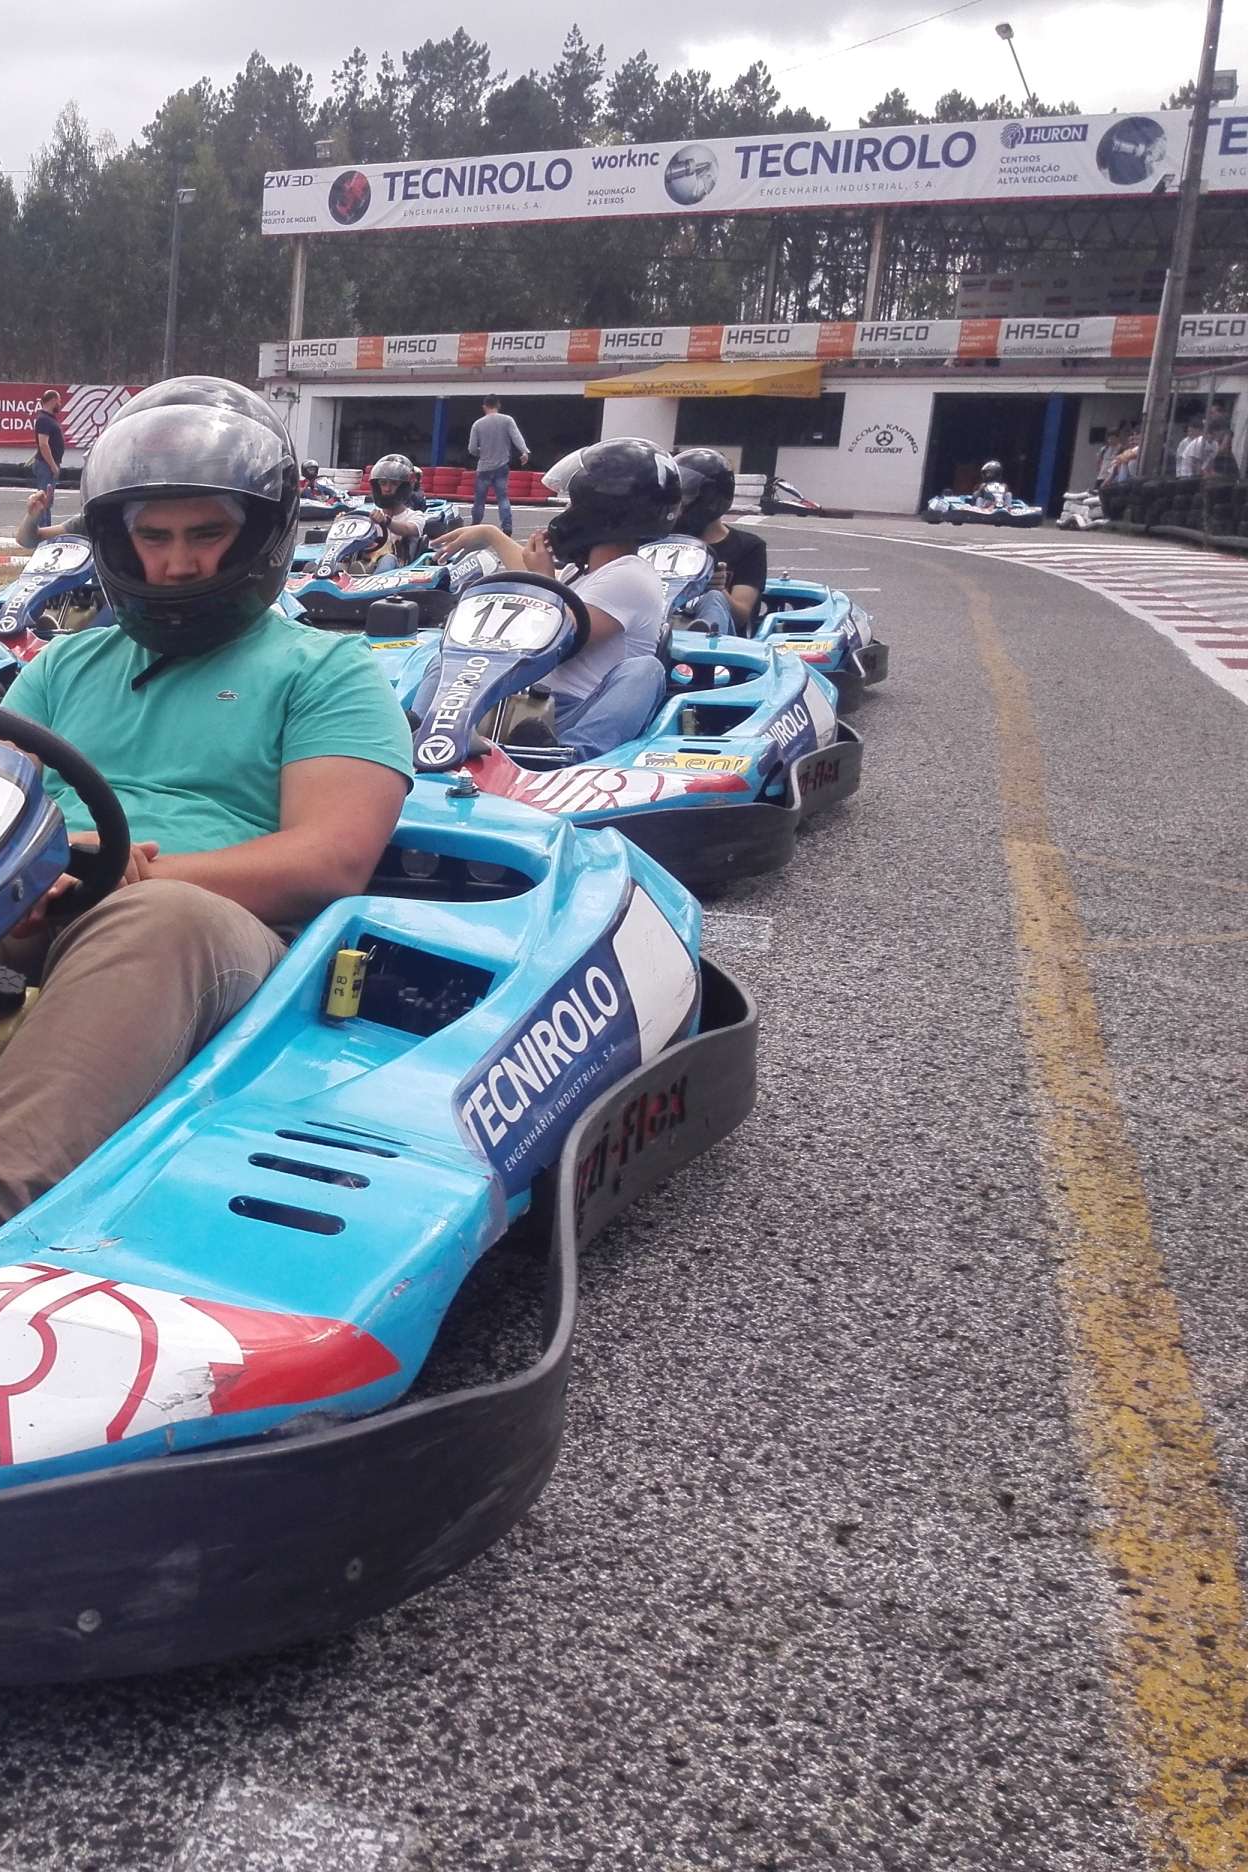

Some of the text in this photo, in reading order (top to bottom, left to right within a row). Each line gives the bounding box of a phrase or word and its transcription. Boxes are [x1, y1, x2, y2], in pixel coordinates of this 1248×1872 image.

[1029, 126, 1083, 142] HURON
[592, 150, 659, 169] worknc
[735, 131, 976, 179] TECNIROLO
[1000, 154, 1041, 164] CENTROS
[383, 158, 573, 201] TECNIROLO
[997, 173, 1079, 185] ALTA VELOCIDADE
[760, 185, 830, 196] ENGENHARIA
[403, 206, 460, 217] ENGENHARIA
[727, 329, 790, 344] HASCO
[860, 326, 929, 342] HASCO
[1005, 323, 1080, 339] HASCO
[1181, 321, 1246, 336] ASCO
[387, 339, 437, 354] HASCO
[491, 336, 545, 350] HASCO
[604, 333, 663, 347] HASCO
[292, 343, 337, 357] HASCO
[848, 424, 918, 454] ESCOLA KARTING
[865, 446, 903, 454] EUROINDY
[334, 522, 357, 536] 30
[44, 547, 63, 567] 3
[646, 548, 680, 572] 11
[476, 595, 553, 611] EUROINDY
[472, 602, 525, 639] 17
[430, 656, 490, 734] TECNIROLO
[761, 703, 809, 749] NIROLO
[460, 966, 619, 1154] TECNIROLO
[504, 1111, 556, 1172] ENGENHARIA
